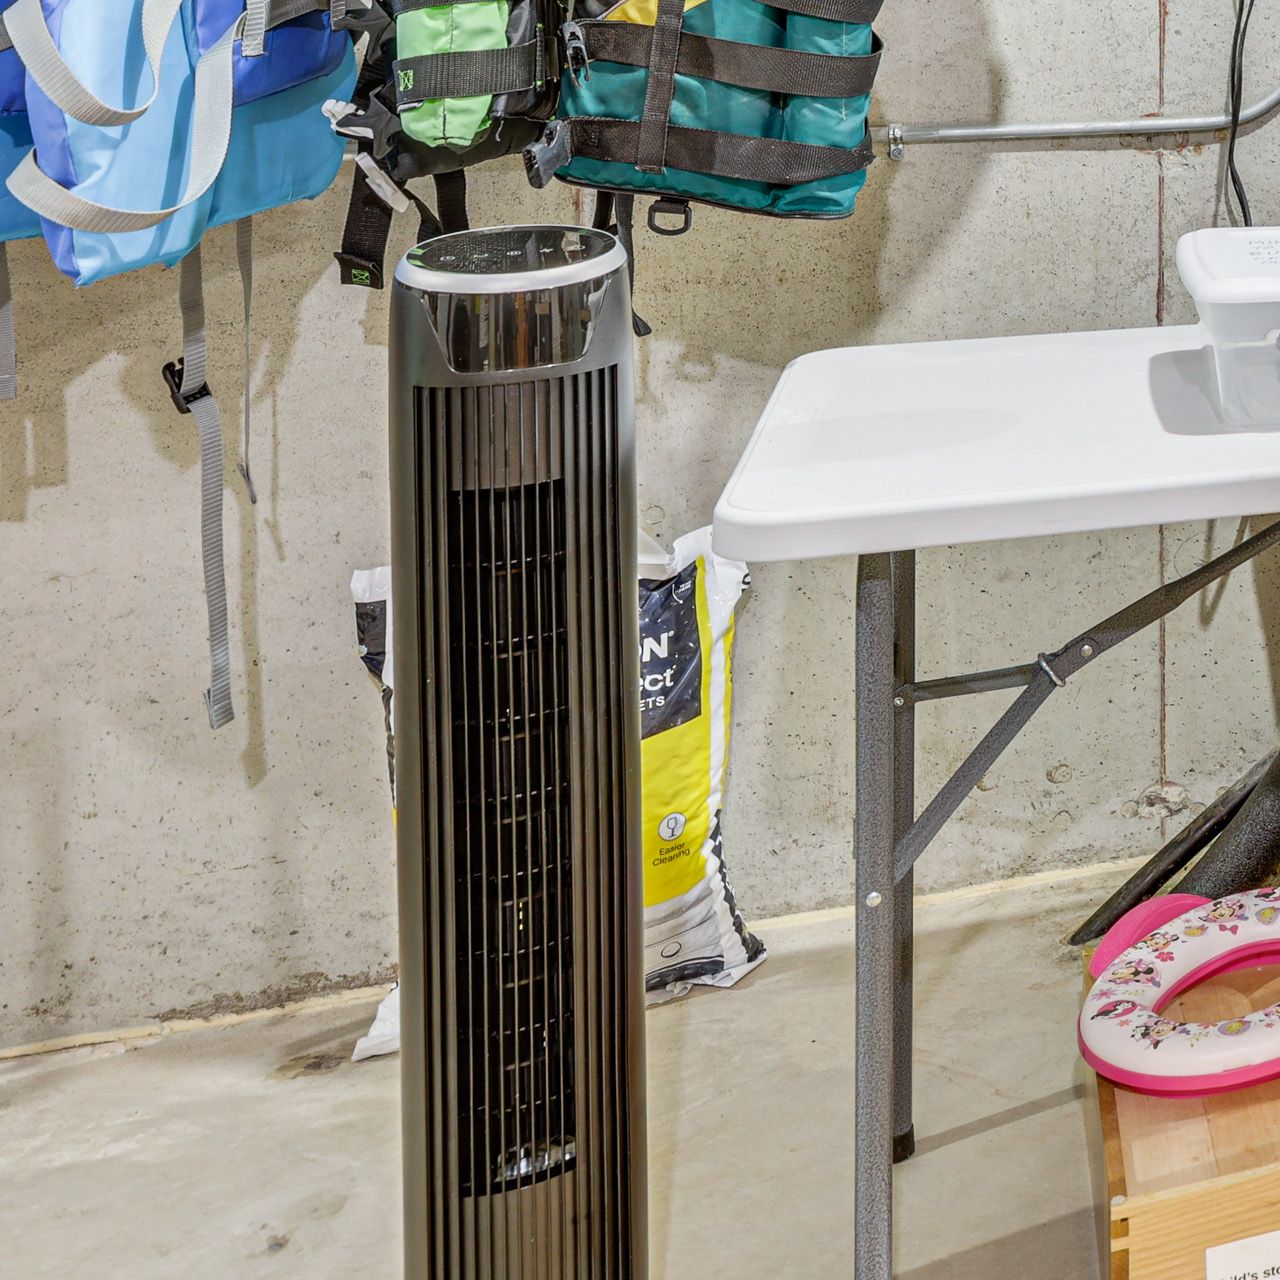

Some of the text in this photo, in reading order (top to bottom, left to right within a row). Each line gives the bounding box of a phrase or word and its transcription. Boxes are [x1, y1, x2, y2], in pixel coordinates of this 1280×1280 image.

[640, 696, 665, 712] ETS
[658, 842, 686, 856] Easier
[652, 849, 691, 867] Cleaning
